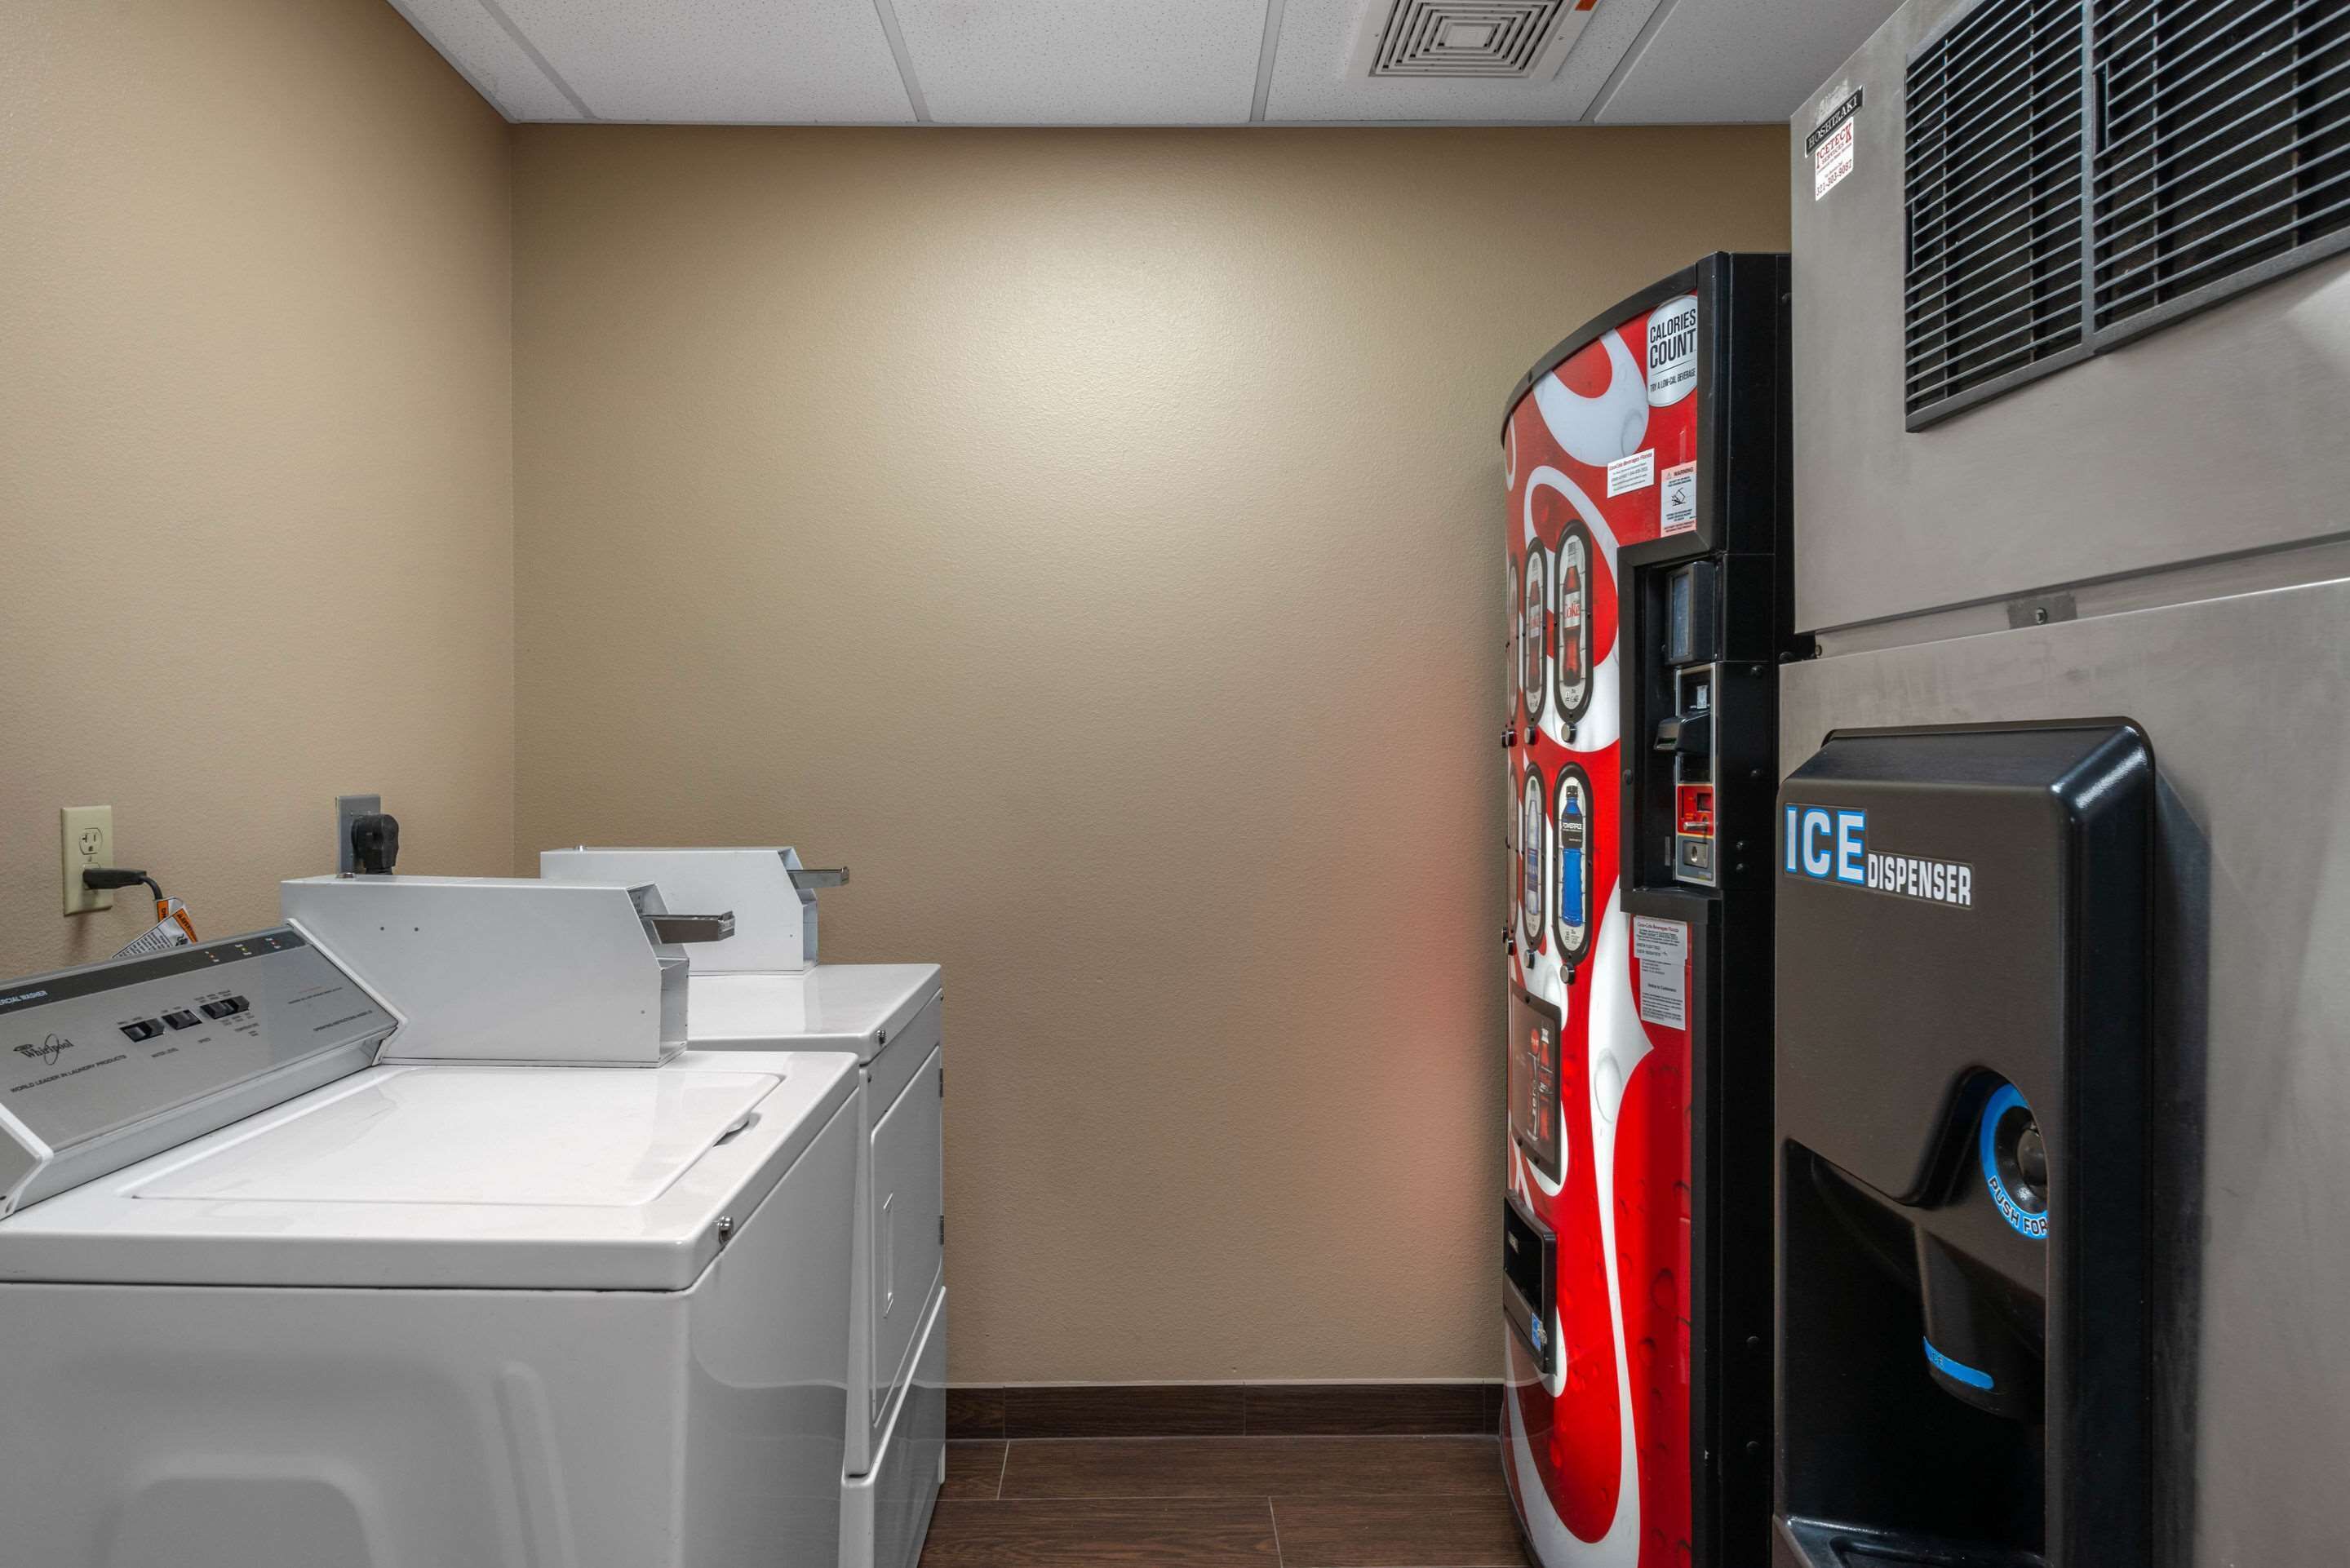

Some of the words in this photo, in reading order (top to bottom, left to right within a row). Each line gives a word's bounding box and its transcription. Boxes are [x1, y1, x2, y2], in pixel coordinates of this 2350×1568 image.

[1807, 94, 1858, 150] HOSHIZAKI
[1816, 122, 1852, 169] ICETECK
[1650, 308, 1696, 343] CALORIES
[1650, 328, 1696, 369] COUNT
[1661, 376, 1677, 389] LOW-CAL
[1677, 367, 1696, 383] BEVERAGE
[1674, 467, 1694, 476] WARNING
[1785, 805, 1867, 885] ICE
[1867, 853, 1972, 906] DISPENSER
[19, 1036, 75, 1062] Whirlpool
[11, 1083, 34, 1093] WORLD
[35, 1074, 60, 1085] LEADER
[69, 1064, 95, 1076] LAUNDRY
[95, 1054, 127, 1066] PRODUCTS
[1988, 1175, 2020, 1228] PUSH
